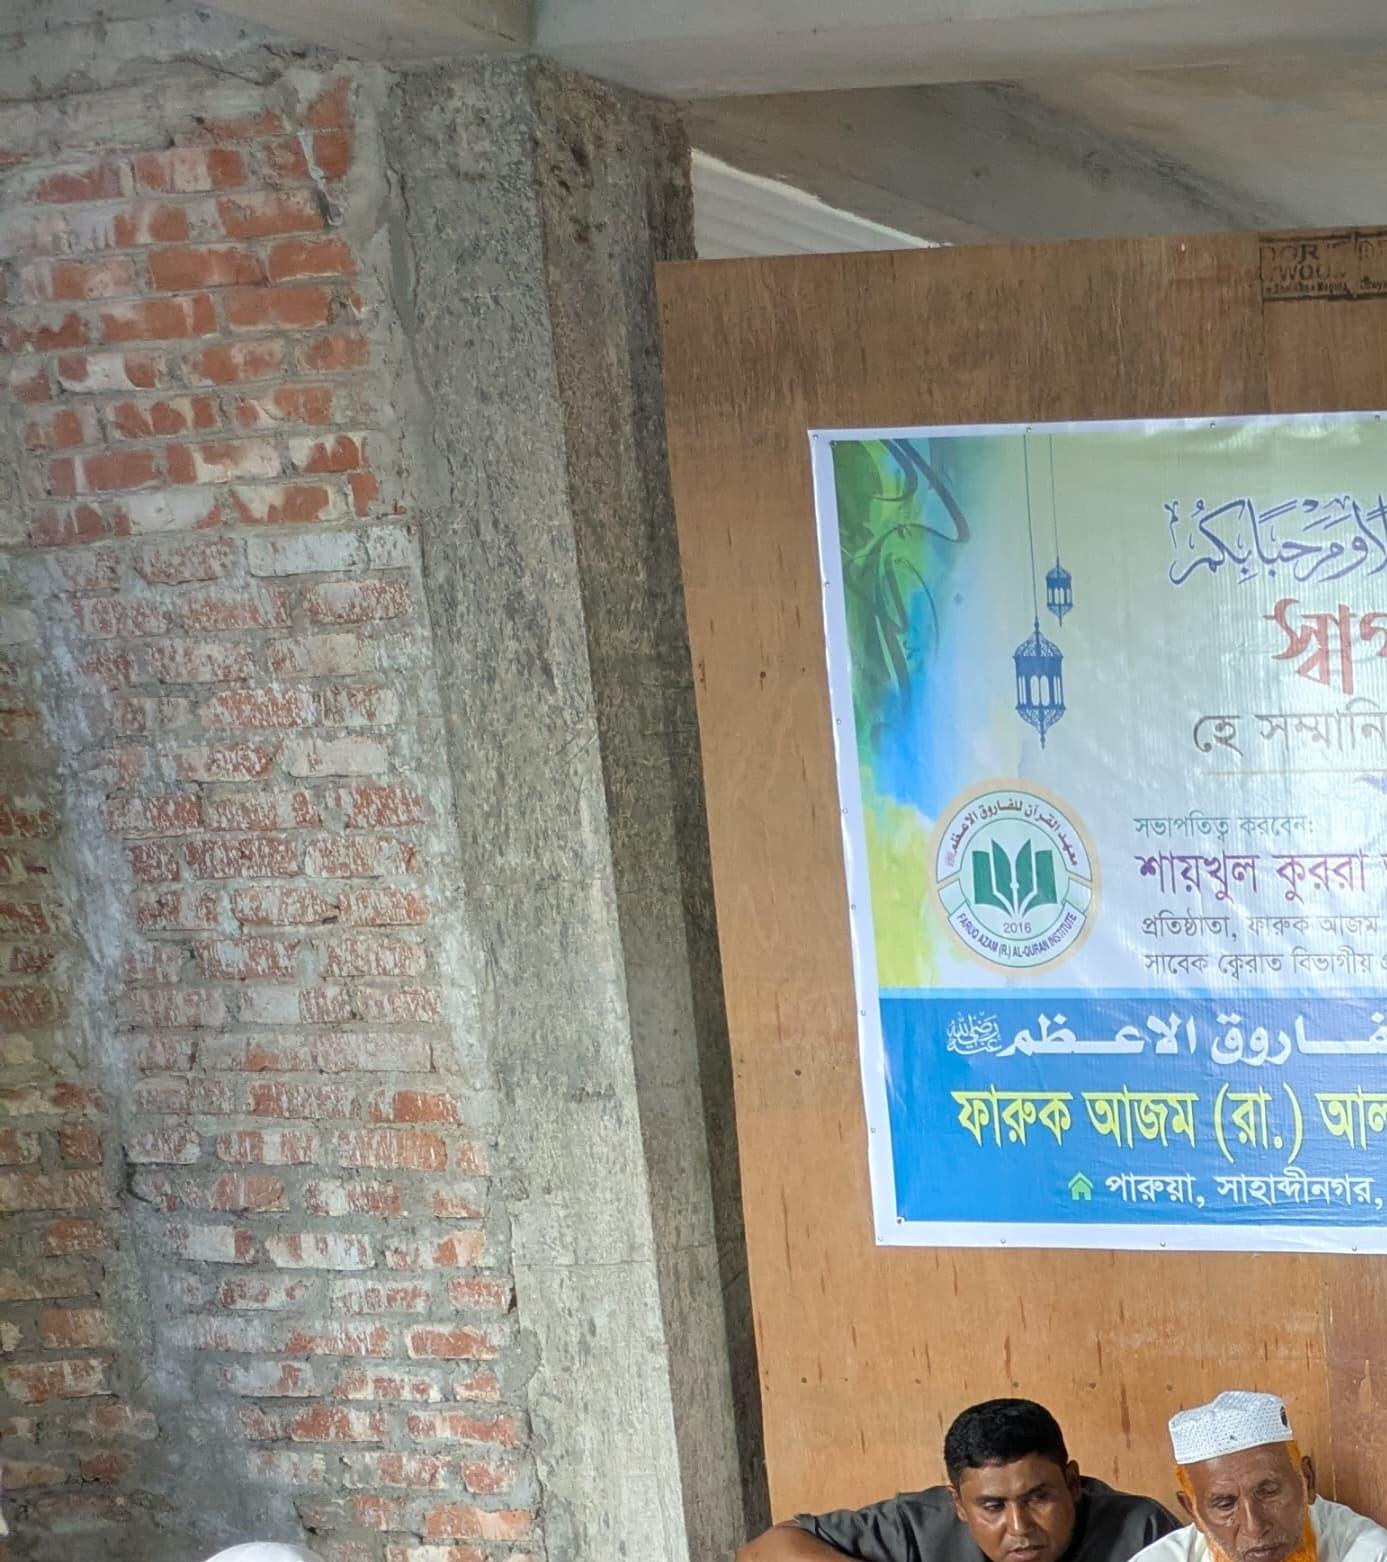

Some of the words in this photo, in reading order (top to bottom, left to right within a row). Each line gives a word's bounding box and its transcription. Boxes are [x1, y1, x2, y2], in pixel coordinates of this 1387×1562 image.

[1193, 713, 1244, 756] হে
[1133, 809, 1230, 841] সভাপতিত্ব
[1134, 848, 1260, 904] শায়খুল
[1272, 847, 1368, 904] কুররা
[1002, 921, 1032, 935] 2016
[1048, 911, 1078, 948] INSTITUTE
[1248, 914, 1310, 938] ফারুক
[1144, 950, 1209, 976] সাবেক
[1291, 945, 1373, 976] বিভাগীয়
[950, 1082, 1074, 1149] ফারুক
[1080, 1083, 1200, 1150] আজম
[1213, 1081, 1304, 1164] (রা.)
[1104, 1171, 1207, 1209] পারুয়া,
